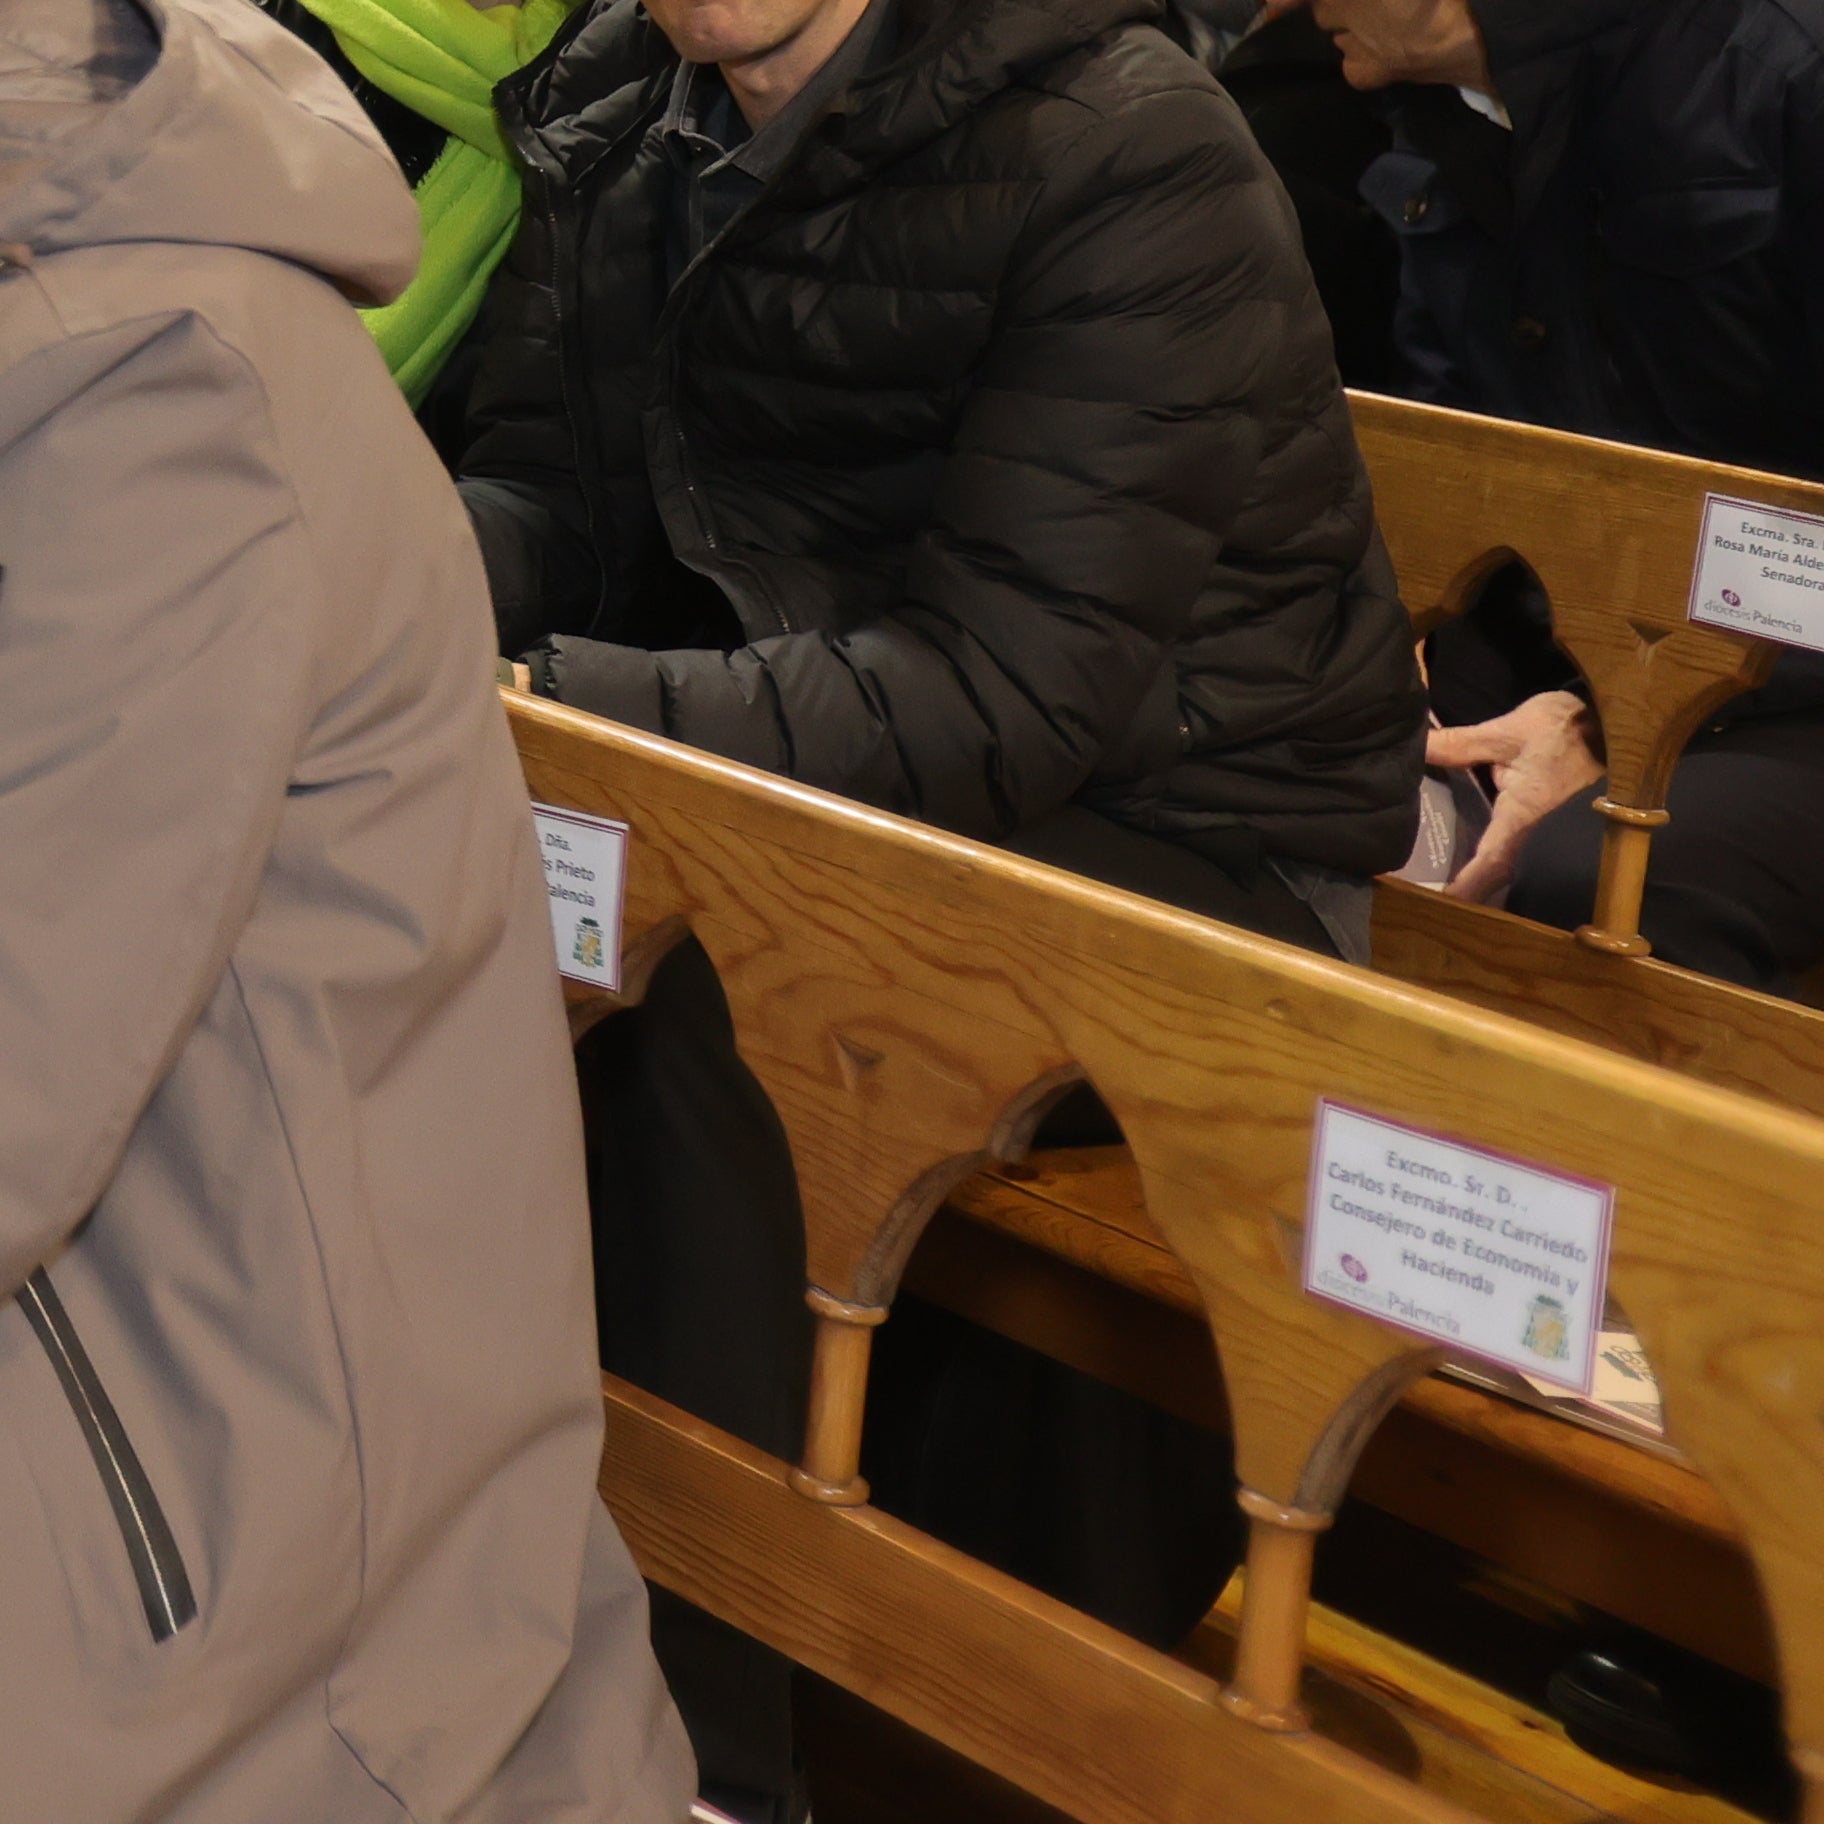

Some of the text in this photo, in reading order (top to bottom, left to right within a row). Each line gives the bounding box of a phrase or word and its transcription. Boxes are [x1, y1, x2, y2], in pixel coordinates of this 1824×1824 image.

[1714, 535, 1745, 553] Rosa
[1748, 542, 1790, 563] María
[1741, 521, 1819, 549] Excma. Sra.
[1760, 566, 1824, 592] Senadora
[1752, 609, 1803, 633] Palencia
[545, 832, 572, 852] Dña.
[556, 859, 596, 882] Prieto
[548, 882, 595, 907] alencia
[1386, 1150, 1458, 1189] Excmo.
[1463, 1174, 1490, 1200] Sr.
[1327, 1161, 1588, 1264] Carlos Fernández Carriedo
[1329, 1193, 1426, 1240] Consejero
[1432, 1229, 1457, 1250] de
[1566, 1278, 1580, 1297] y
[1402, 1249, 1496, 1296] Hacienda
[1388, 1290, 1461, 1335] Palencia
